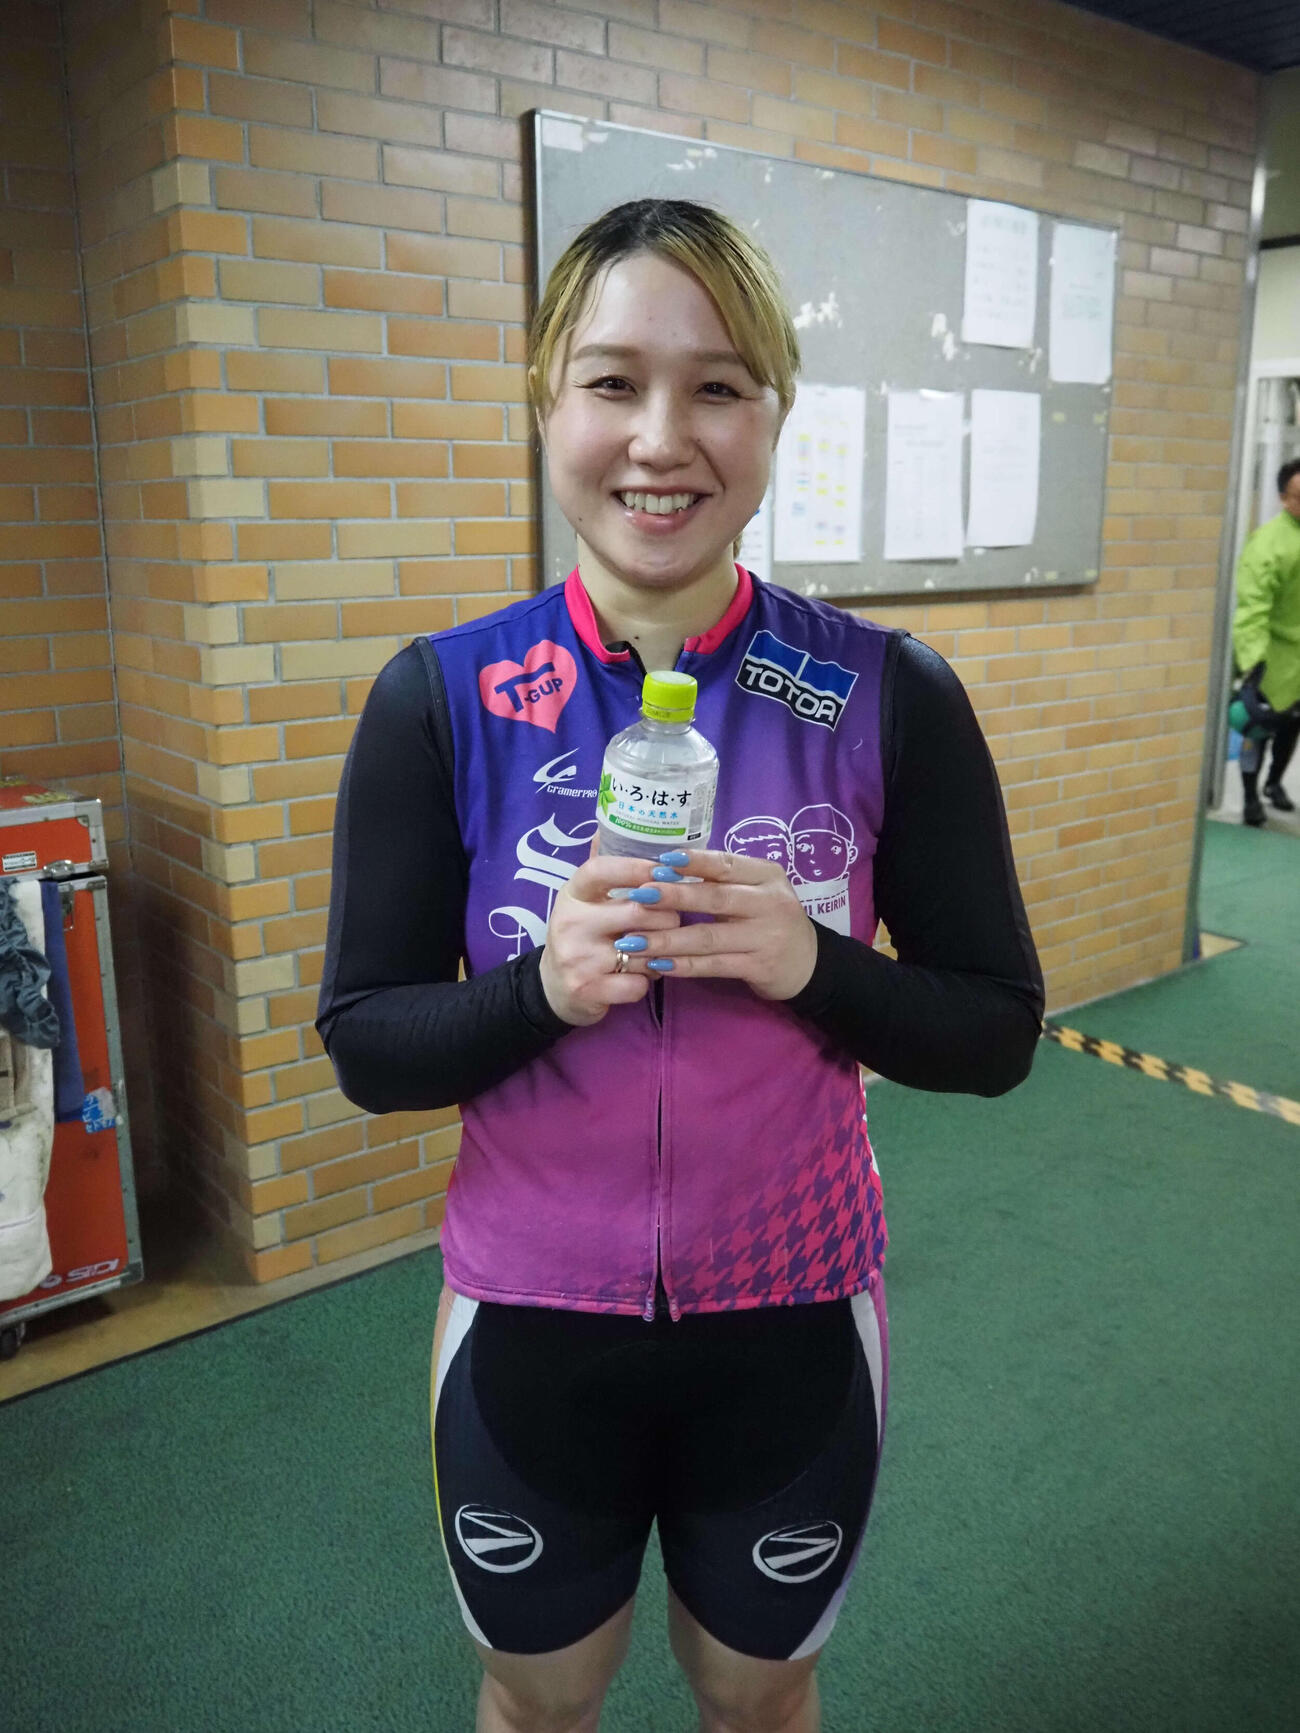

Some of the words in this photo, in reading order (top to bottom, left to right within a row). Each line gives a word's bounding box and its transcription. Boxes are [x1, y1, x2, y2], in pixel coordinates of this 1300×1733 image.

[618, 802, 679, 820] 日本の天然水
[817, 895, 846, 915] KEIRIN
